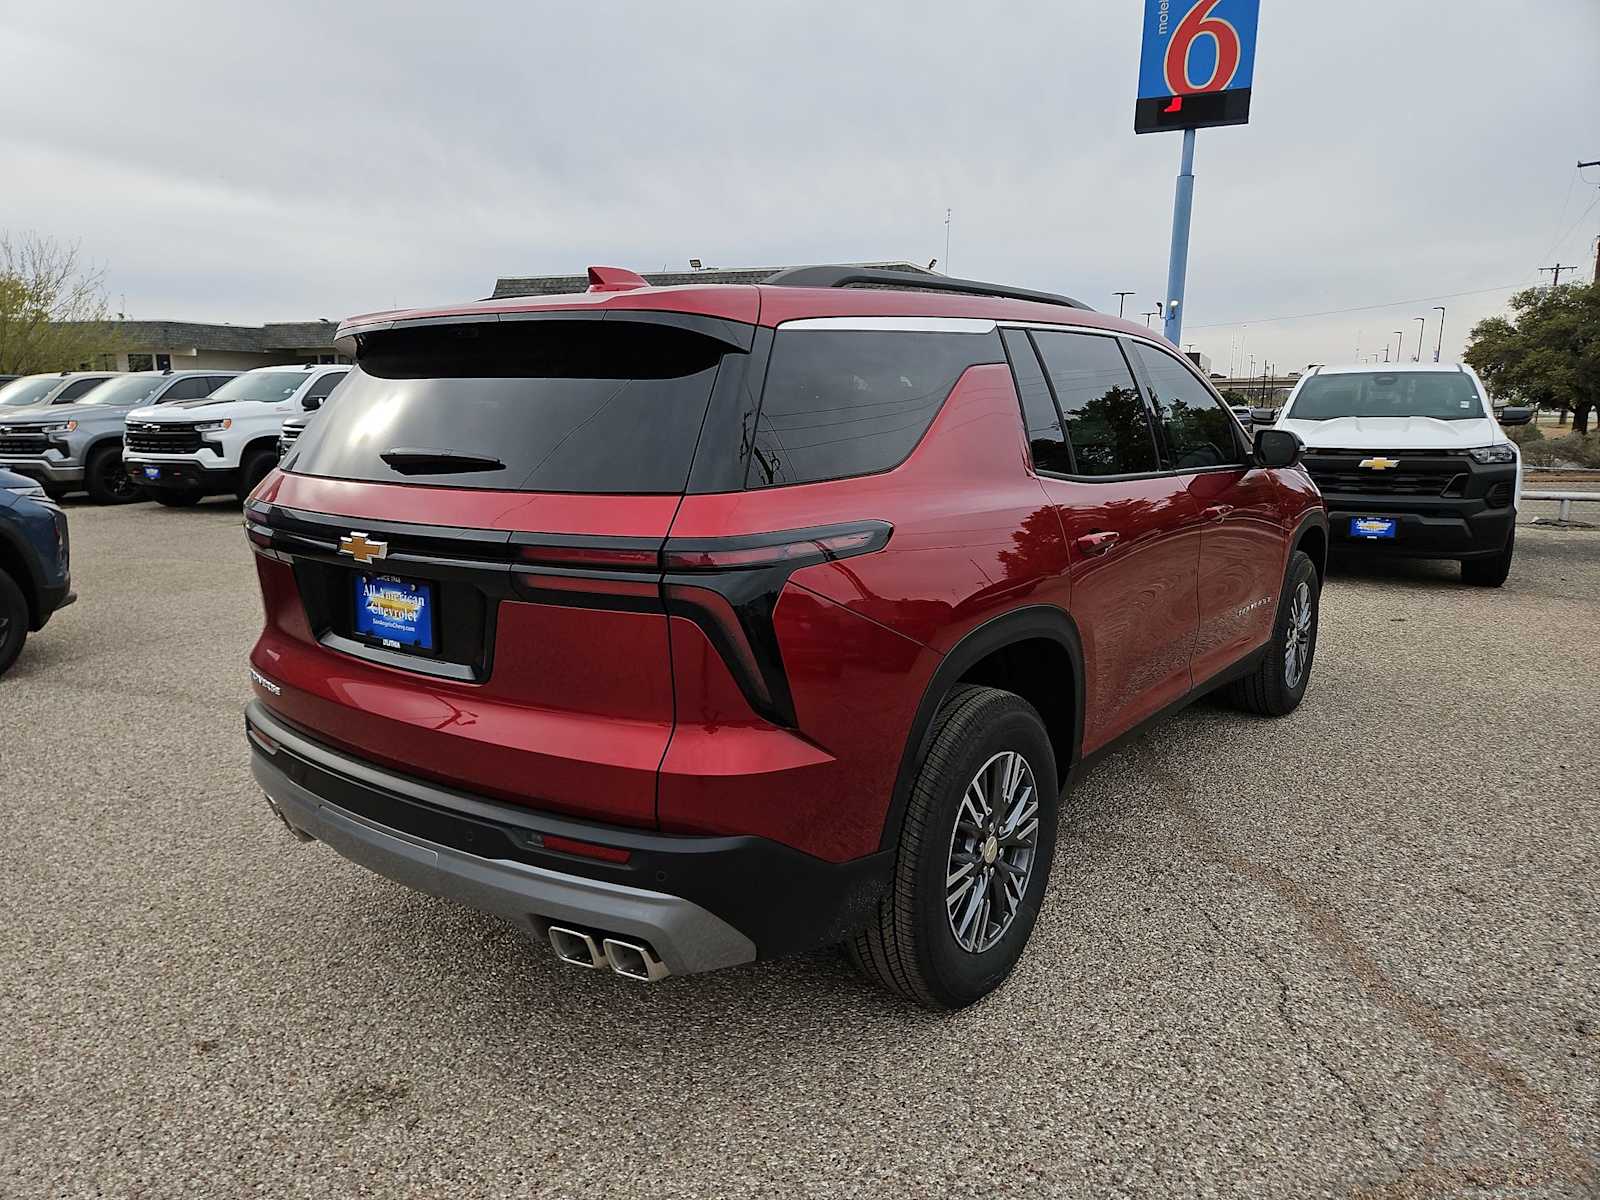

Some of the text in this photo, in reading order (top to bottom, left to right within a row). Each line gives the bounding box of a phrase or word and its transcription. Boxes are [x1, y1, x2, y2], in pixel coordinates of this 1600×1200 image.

[1163, 0, 1241, 95] 6
[363, 583, 425, 607] All American
[370, 601, 417, 622] Chevrolet
